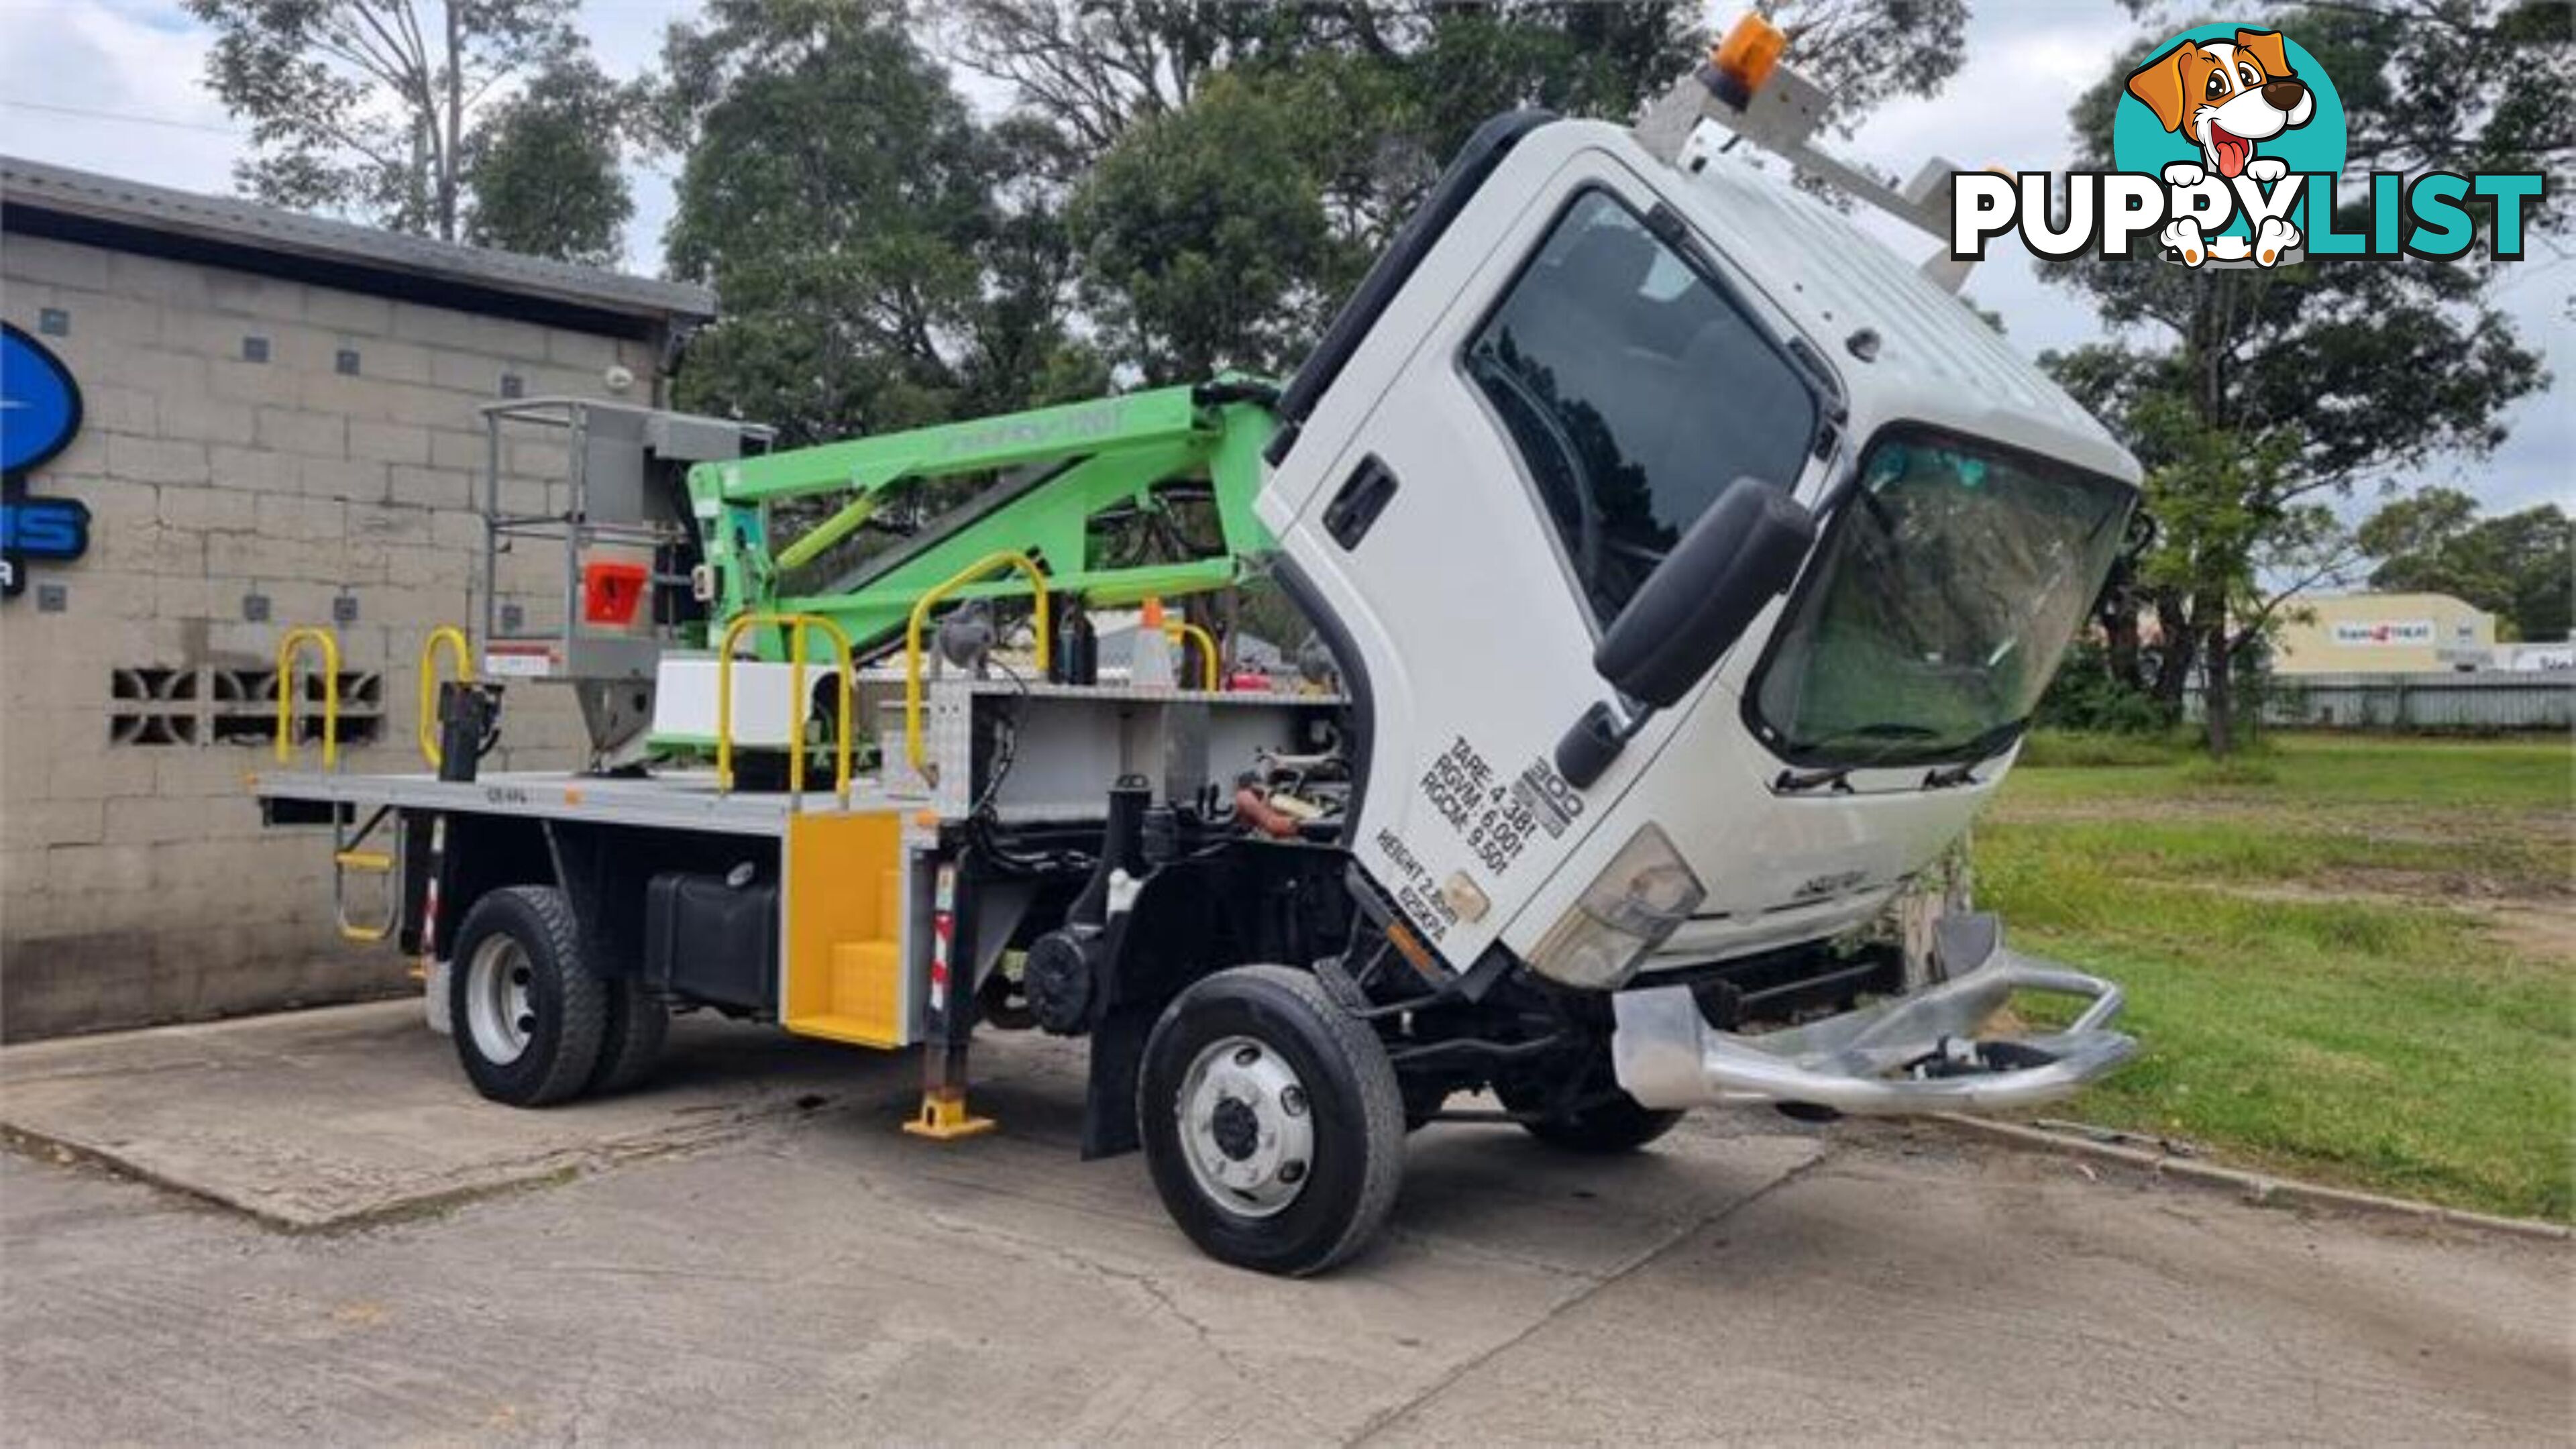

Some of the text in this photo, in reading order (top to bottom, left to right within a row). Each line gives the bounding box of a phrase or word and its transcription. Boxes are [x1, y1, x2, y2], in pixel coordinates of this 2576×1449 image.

[0, 505, 76, 549] S
[1528, 755, 1585, 818] 300
[1377, 828, 1424, 881] HEIGHT
[1466, 827, 1507, 875] 9.50t
[1481, 809, 1523, 859] 6.00t
